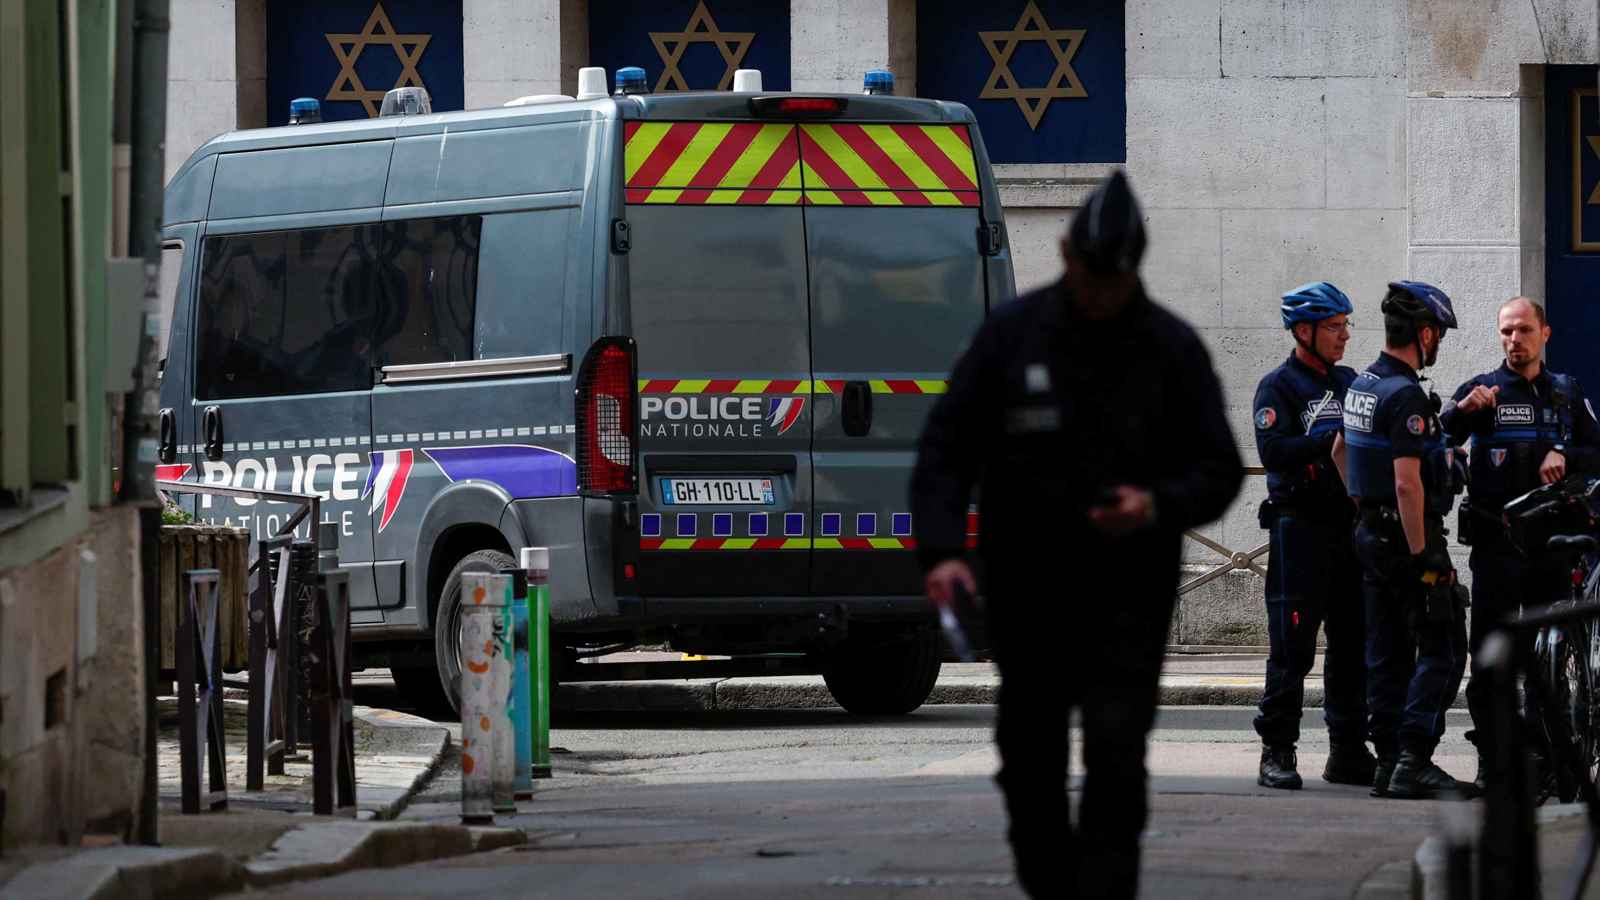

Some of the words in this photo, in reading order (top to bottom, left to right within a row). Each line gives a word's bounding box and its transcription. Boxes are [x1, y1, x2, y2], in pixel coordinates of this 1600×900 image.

[640, 397, 762, 420] POLICE
[1500, 407, 1531, 415] POLICE
[640, 423, 762, 437] NATIONALE
[201, 453, 360, 509] POLICE
